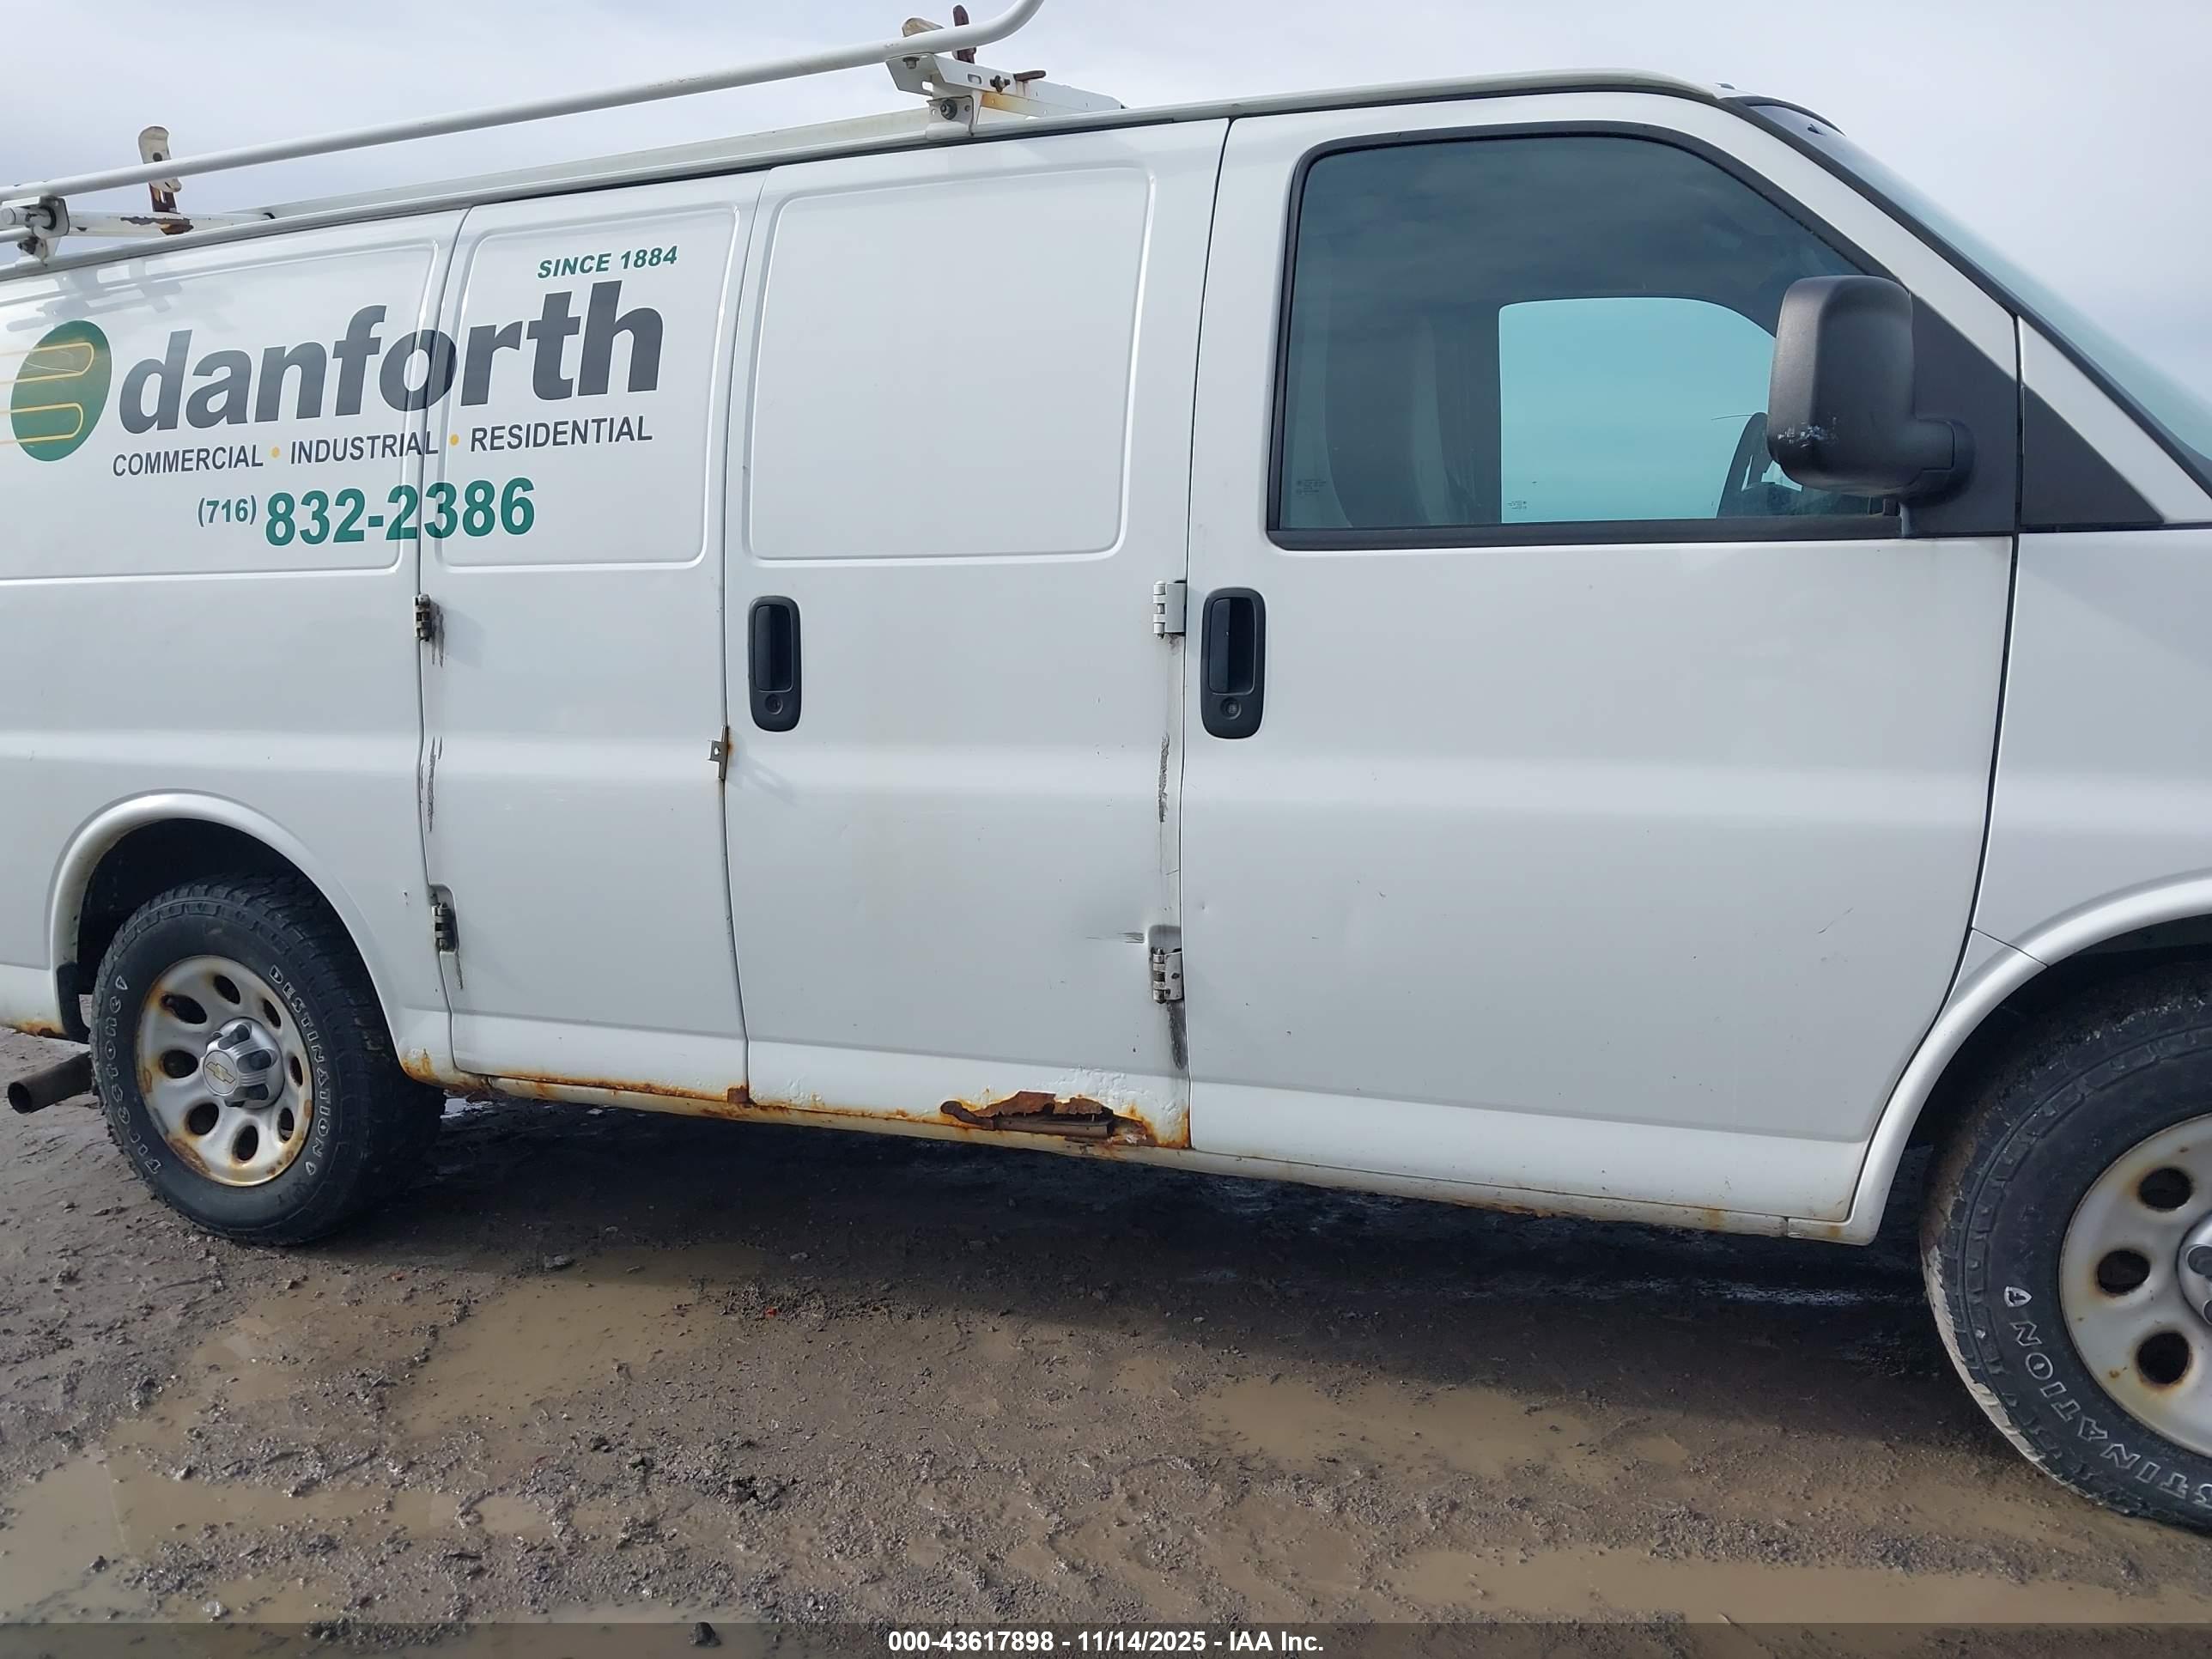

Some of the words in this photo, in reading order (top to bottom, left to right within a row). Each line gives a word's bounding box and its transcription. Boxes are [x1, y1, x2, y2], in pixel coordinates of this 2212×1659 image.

[537, 252, 612, 280] SINCE
[619, 246, 678, 270] 1884
[118, 280, 664, 435] danforth
[112, 443, 264, 477] COMMERCIAL
[289, 431, 440, 465] INDUSTRIAL
[470, 415, 654, 453] RESIDENTIAL
[197, 494, 258, 528] (716)
[264, 476, 537, 547] 832-2386
[270, 965, 331, 1158] DESTINATION
